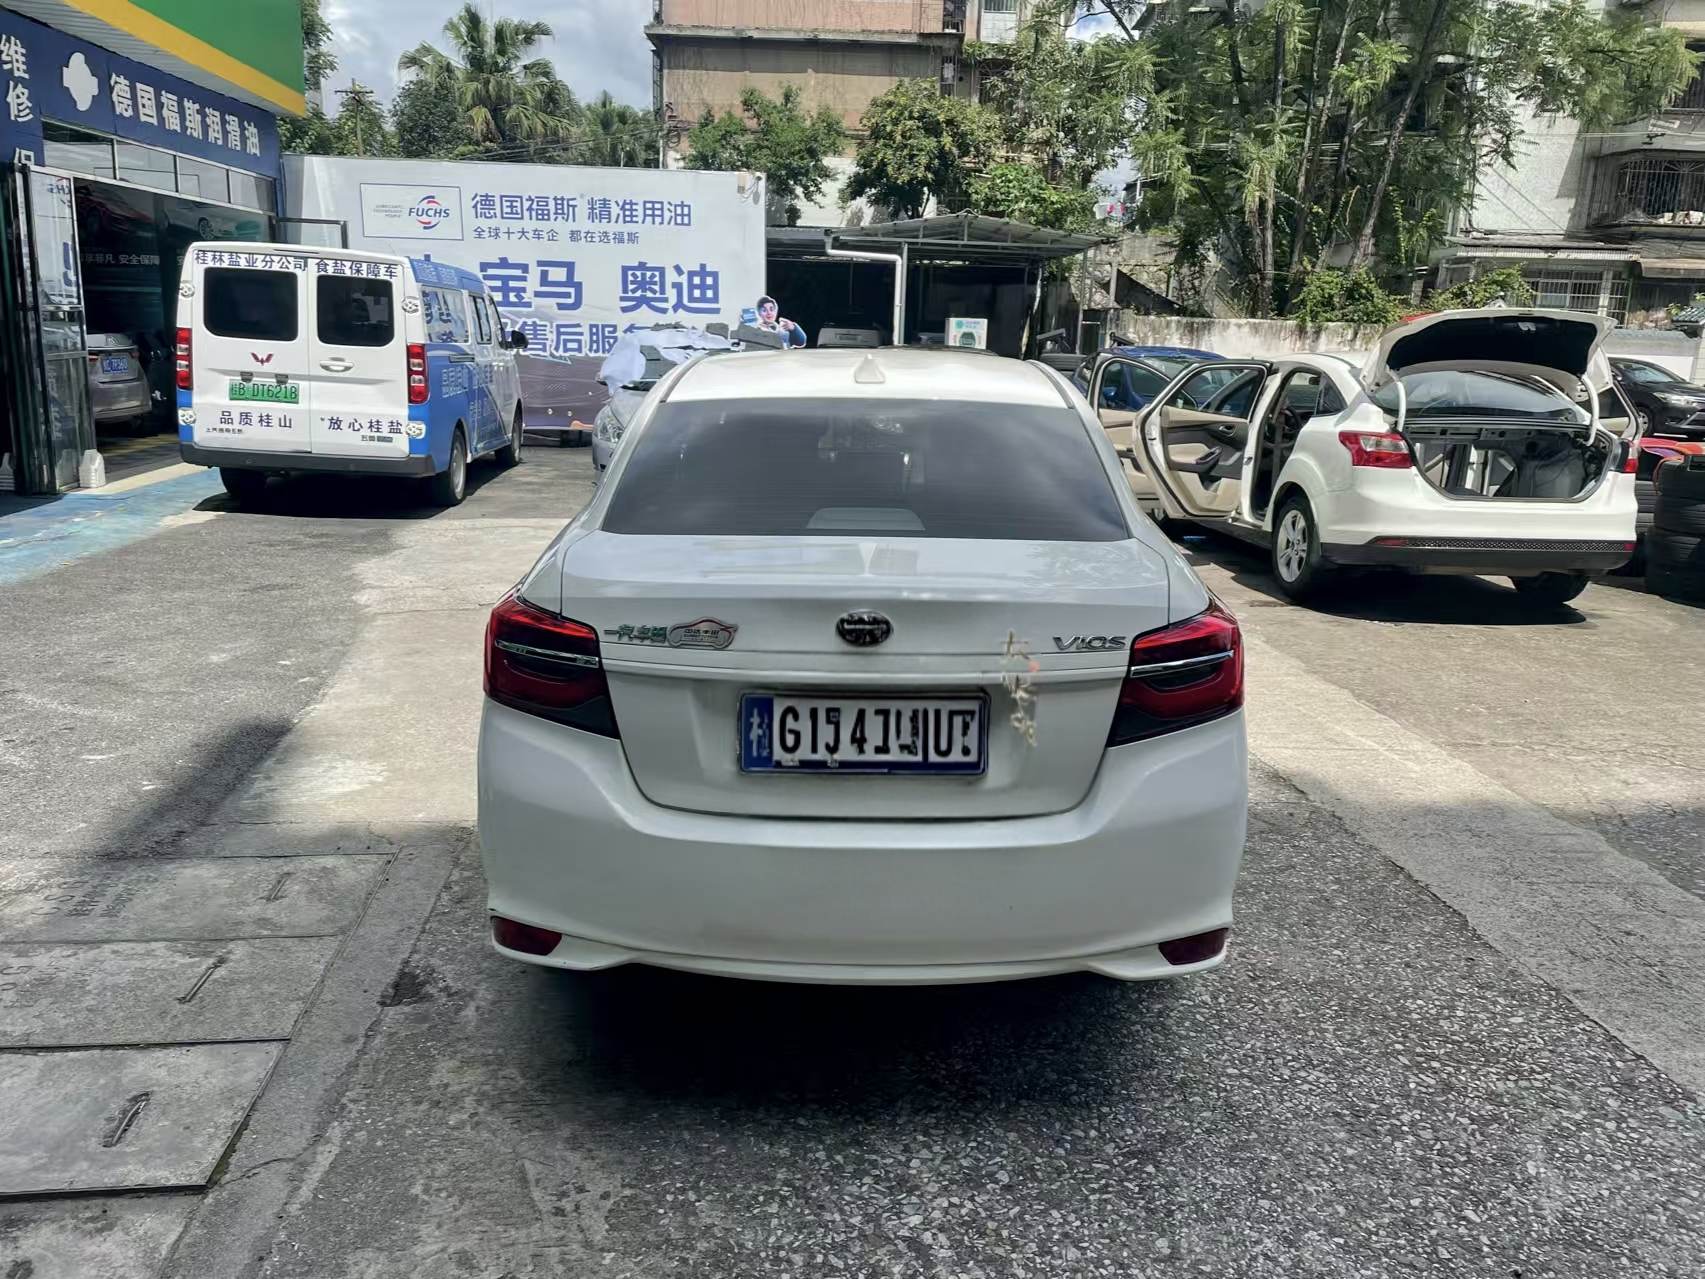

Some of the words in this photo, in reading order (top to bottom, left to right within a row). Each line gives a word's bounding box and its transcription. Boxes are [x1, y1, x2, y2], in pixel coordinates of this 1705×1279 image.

[0, 34, 33, 122] 维修
[110, 72, 262, 157] 德国福斯润滑油
[408, 207, 450, 218] FUCHS
[471, 192, 578, 223] 德国福斯
[587, 197, 692, 227] 精准用油
[473, 226, 559, 242] 全球十大车企
[568, 229, 640, 245] 都在选福斯
[195, 251, 308, 272] 桂林盐业分公司
[315, 260, 398, 280] 食盐保障车
[479, 257, 583, 311] 宝马
[619, 261, 721, 314] 奥迪
[220, 410, 292, 429] 品质桂山
